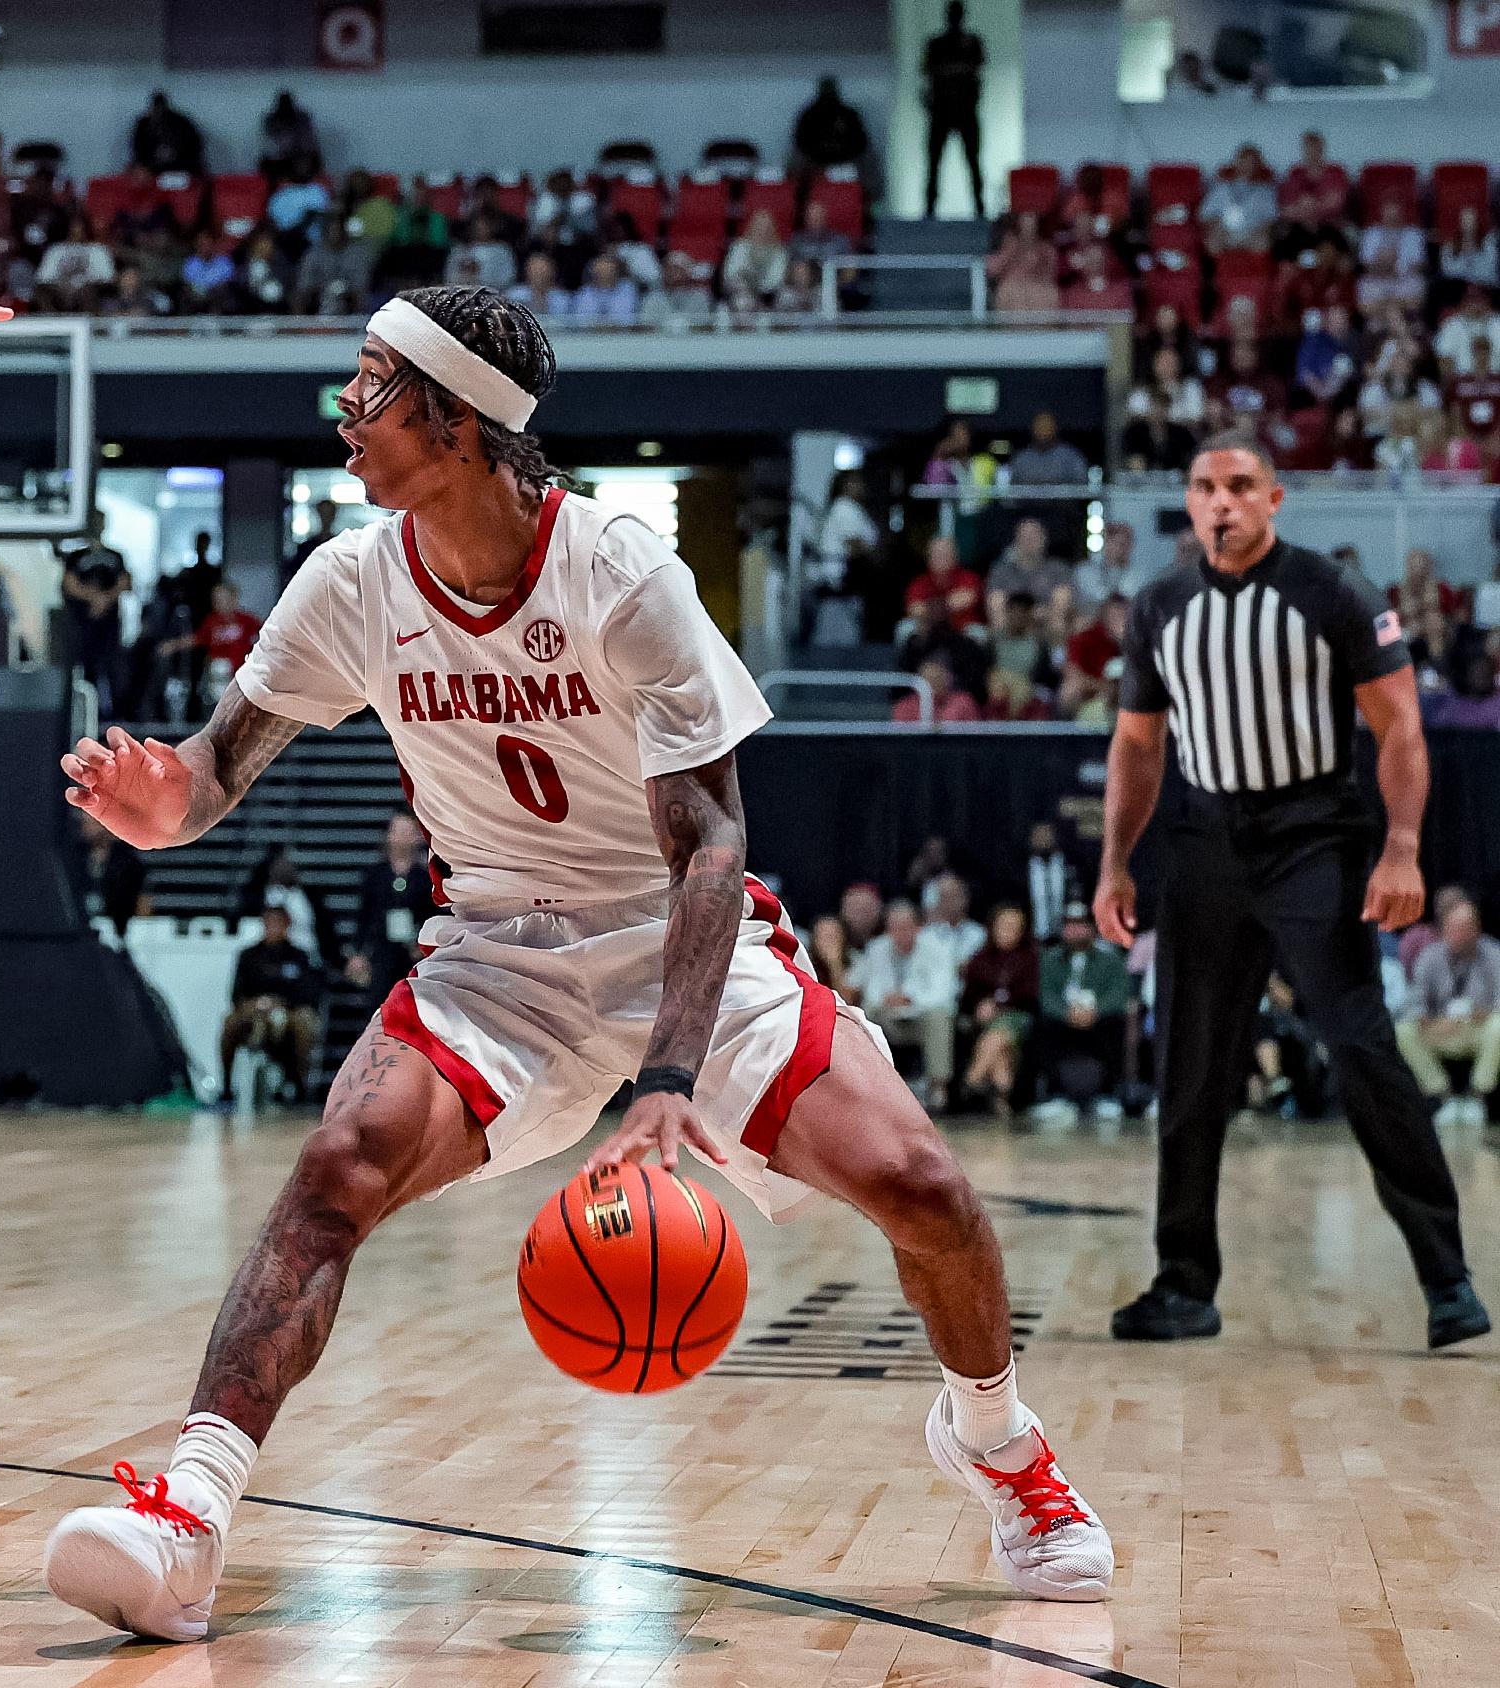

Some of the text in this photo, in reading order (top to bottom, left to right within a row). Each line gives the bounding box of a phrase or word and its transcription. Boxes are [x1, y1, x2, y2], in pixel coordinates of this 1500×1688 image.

[324, 8, 373, 62] Q
[525, 622, 562, 661] SEC
[397, 671, 602, 724] ALABAMA
[495, 733, 570, 824] 0
